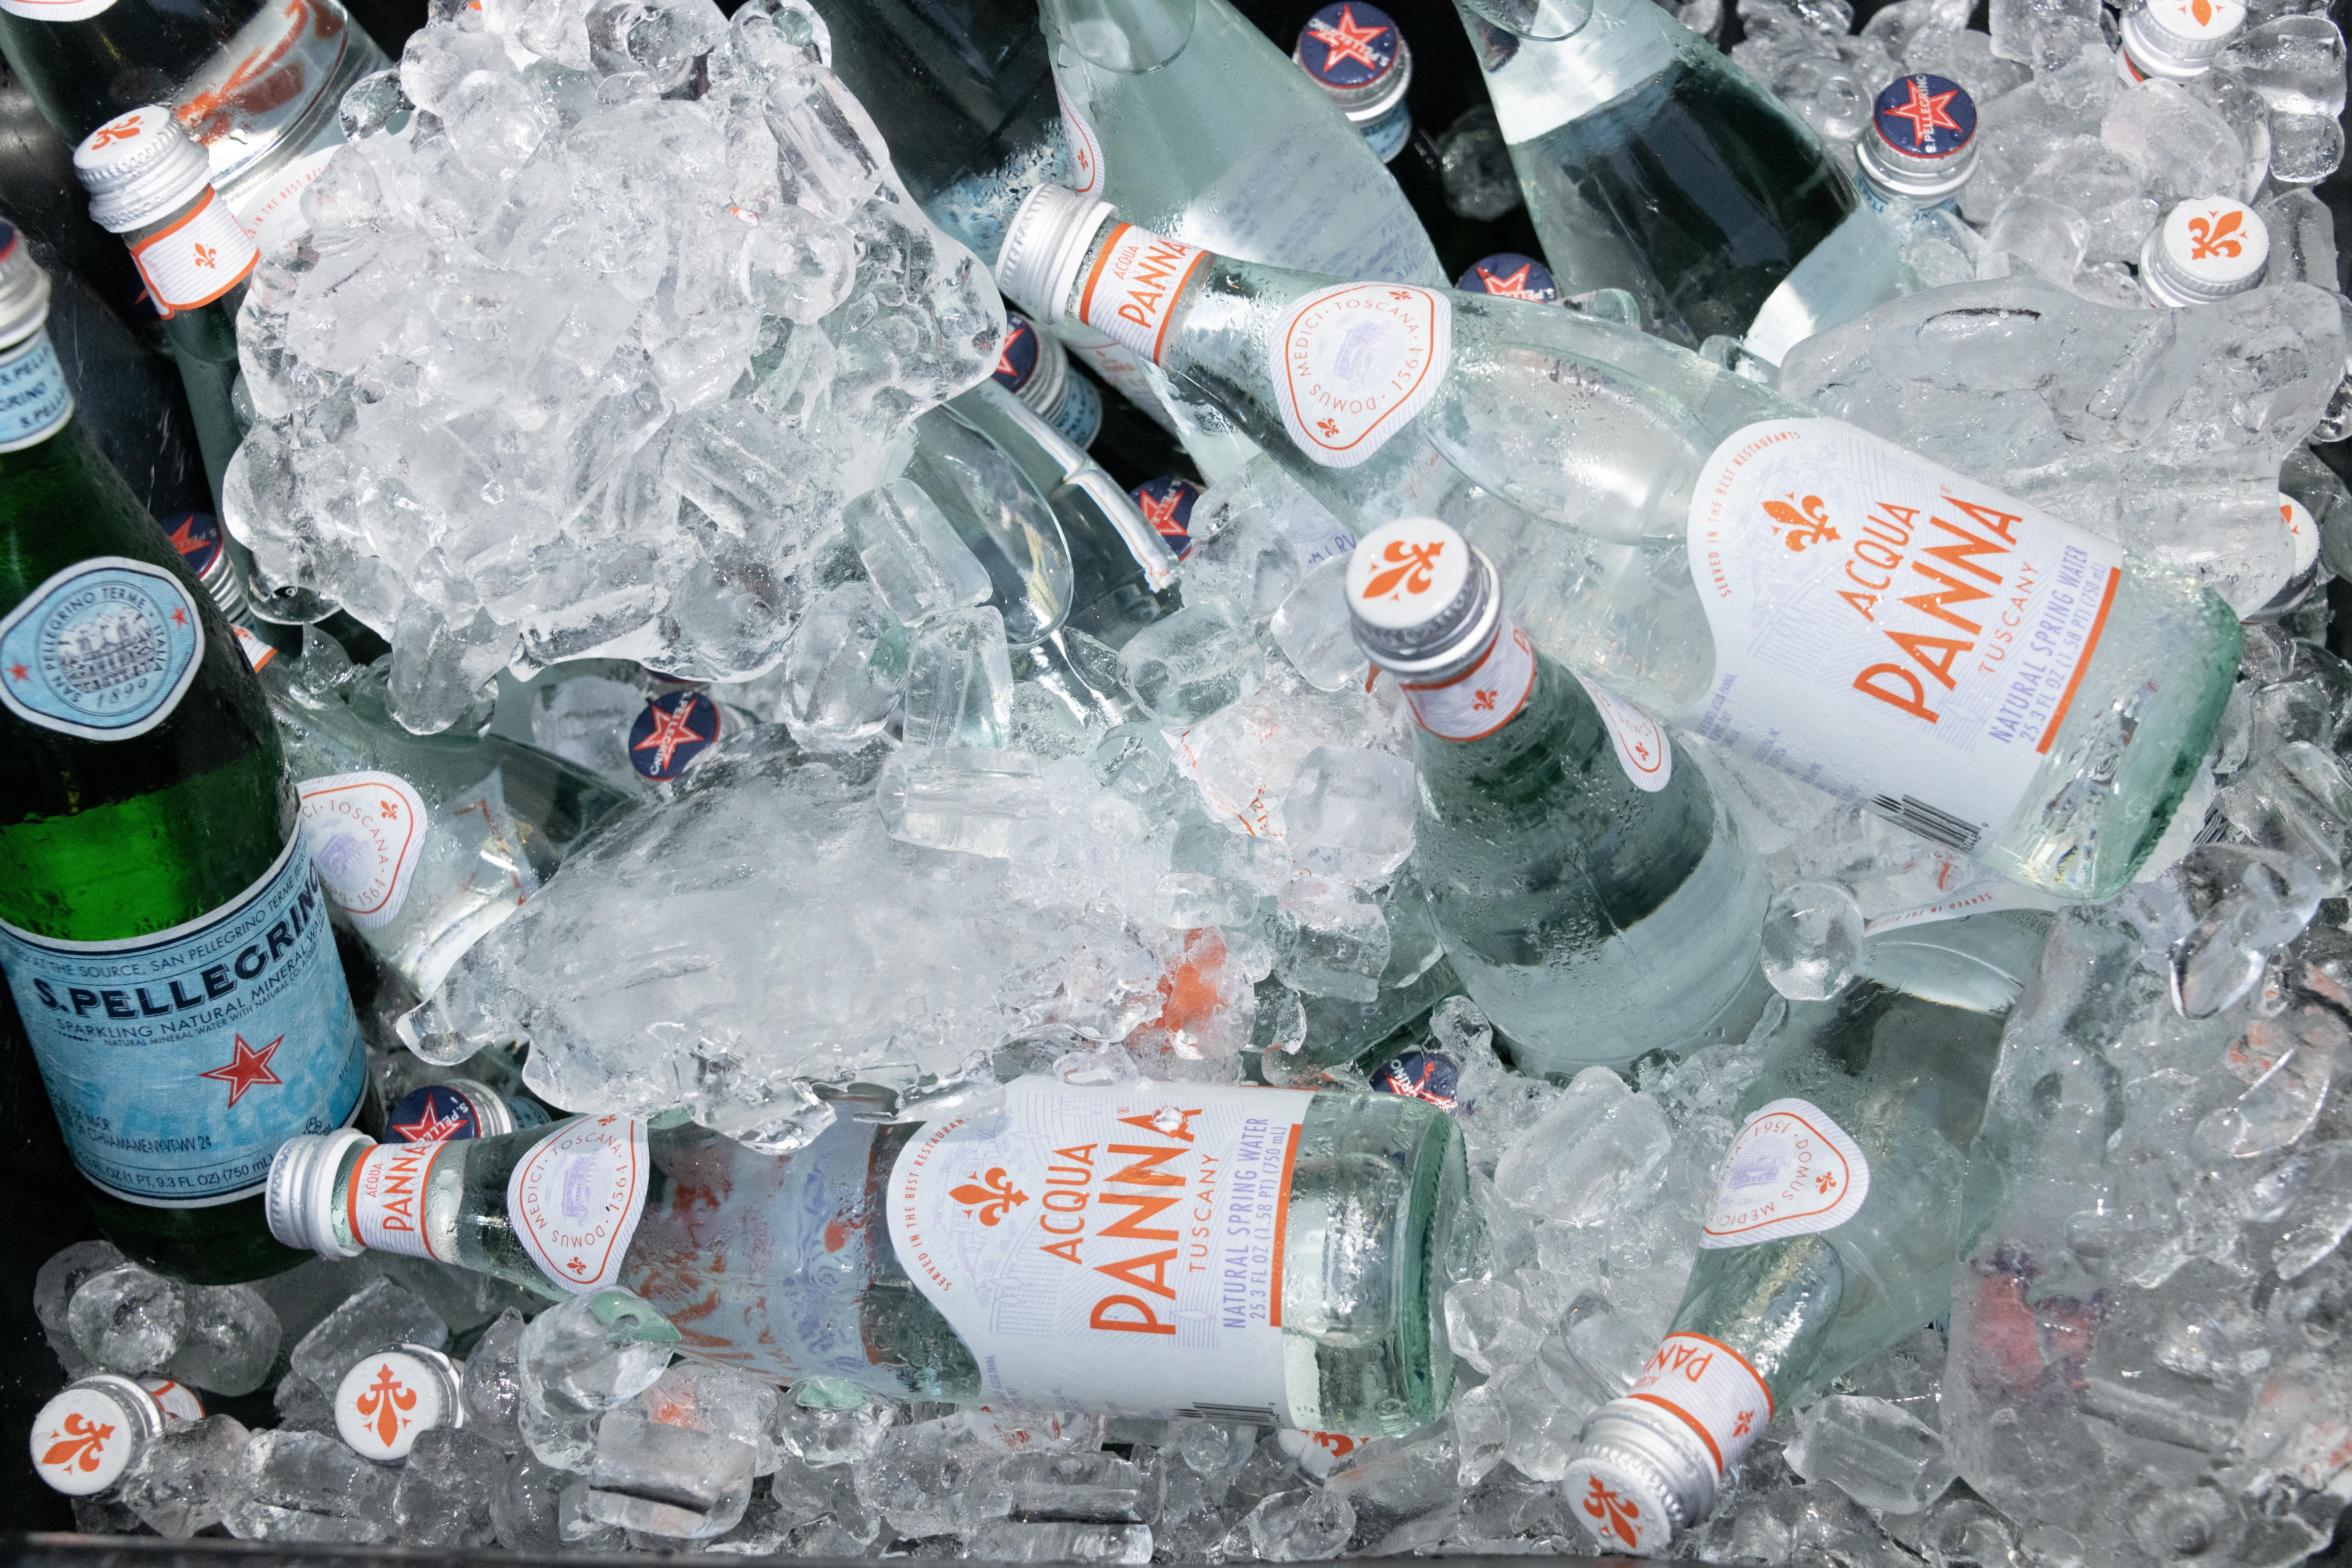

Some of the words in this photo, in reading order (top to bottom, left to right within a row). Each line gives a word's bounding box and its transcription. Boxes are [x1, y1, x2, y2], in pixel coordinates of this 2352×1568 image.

[1113, 245, 1140, 281] ACQUA
[1118, 239, 1192, 329] PANNA
[1334, 299, 1419, 333] TOSCANA
[1295, 312, 1324, 377] MEDICI
[1391, 348, 1423, 390] 1564
[1310, 384, 1376, 414] DOMUS
[1732, 430, 1802, 467] RESTAURANTS
[1716, 467, 1736, 495] BEST
[1708, 501, 1723, 522] THE
[1707, 530, 1718, 543] IN
[1708, 551, 1732, 598] SERVED
[1836, 501, 1921, 622] ACQUA
[2090, 563, 2108, 582] mL)
[102, 588, 146, 610] TERME
[1851, 494, 2023, 724] PANNA
[2079, 580, 2101, 610] (750
[43, 591, 95, 670] PELLEGRINO
[1978, 561, 2039, 675] TUSCANY
[2070, 608, 2094, 631] PT)
[1988, 661, 2047, 744] NATURAL
[2030, 589, 2074, 658] SPRING
[2056, 544, 2089, 589] WATER
[2056, 630, 2082, 669] (1.58
[52, 676, 82, 702] SAN
[2045, 669, 2066, 690] OZ
[2030, 692, 2056, 713] FL
[2019, 709, 2046, 742] 25.3
[330, 800, 389, 865] TOSCANA
[357, 878, 386, 907] 1564
[1949, 892, 1993, 909] SERVED
[34, 856, 320, 1020] S.PELLEGRINO
[48, 962, 75, 975] THE
[79, 964, 146, 978] SOURCE,
[150, 953, 185, 971] SAN
[189, 909, 266, 961] PELLEGRINO
[267, 878, 295, 913] TERME
[56, 1018, 153, 1039] SPARKLING
[160, 998, 247, 1032] NATURAL
[252, 945, 308, 1001] MINERAL
[308, 899, 323, 942] WATER
[103, 1038, 147, 1047] NATURAL
[150, 1029, 193, 1046] MINERAL
[195, 1019, 228, 1035] WATER
[230, 1006, 253, 1022] WITH
[255, 980, 289, 1010] NATURAL
[551, 1132, 622, 1155] TOSCANA
[1237, 1117, 1269, 1164] WATER
[1270, 1126, 1288, 1145] mL)
[136, 1176, 155, 1188] PT,
[158, 1177, 176, 1188] 9.3
[179, 1176, 196, 1187] FL
[198, 1172, 221, 1186] OZ)
[223, 1164, 250, 1183] (750
[252, 1154, 274, 1173] mL)
[366, 1162, 384, 1198] ACQUA
[1262, 1147, 1282, 1177] (750
[1782, 1139, 1812, 1201] DOMUS
[381, 1144, 434, 1232] PANNA
[528, 1165, 548, 1229] MEDICI
[609, 1164, 628, 1211] 1564
[905, 1171, 920, 1199] BEST
[1227, 1170, 1258, 1236] SPRING
[1258, 1177, 1279, 1199] PT)
[905, 1206, 917, 1228] THE
[1038, 1143, 1098, 1265] ACQUA
[1089, 1108, 1203, 1335] PANNA
[1189, 1153, 1219, 1273] TUSCANY
[1255, 1203, 1273, 1241] (1.58
[1716, 1202, 1775, 1226] MEDICI
[552, 1225, 605, 1248] DOMUS
[910, 1234, 922, 1248] IN
[918, 1252, 952, 1292] SERVED
[1252, 1246, 1269, 1265] OZ
[1222, 1245, 1249, 1328] NATURAL
[1251, 1269, 1267, 1285] FL
[1250, 1289, 1266, 1320] 25.3
